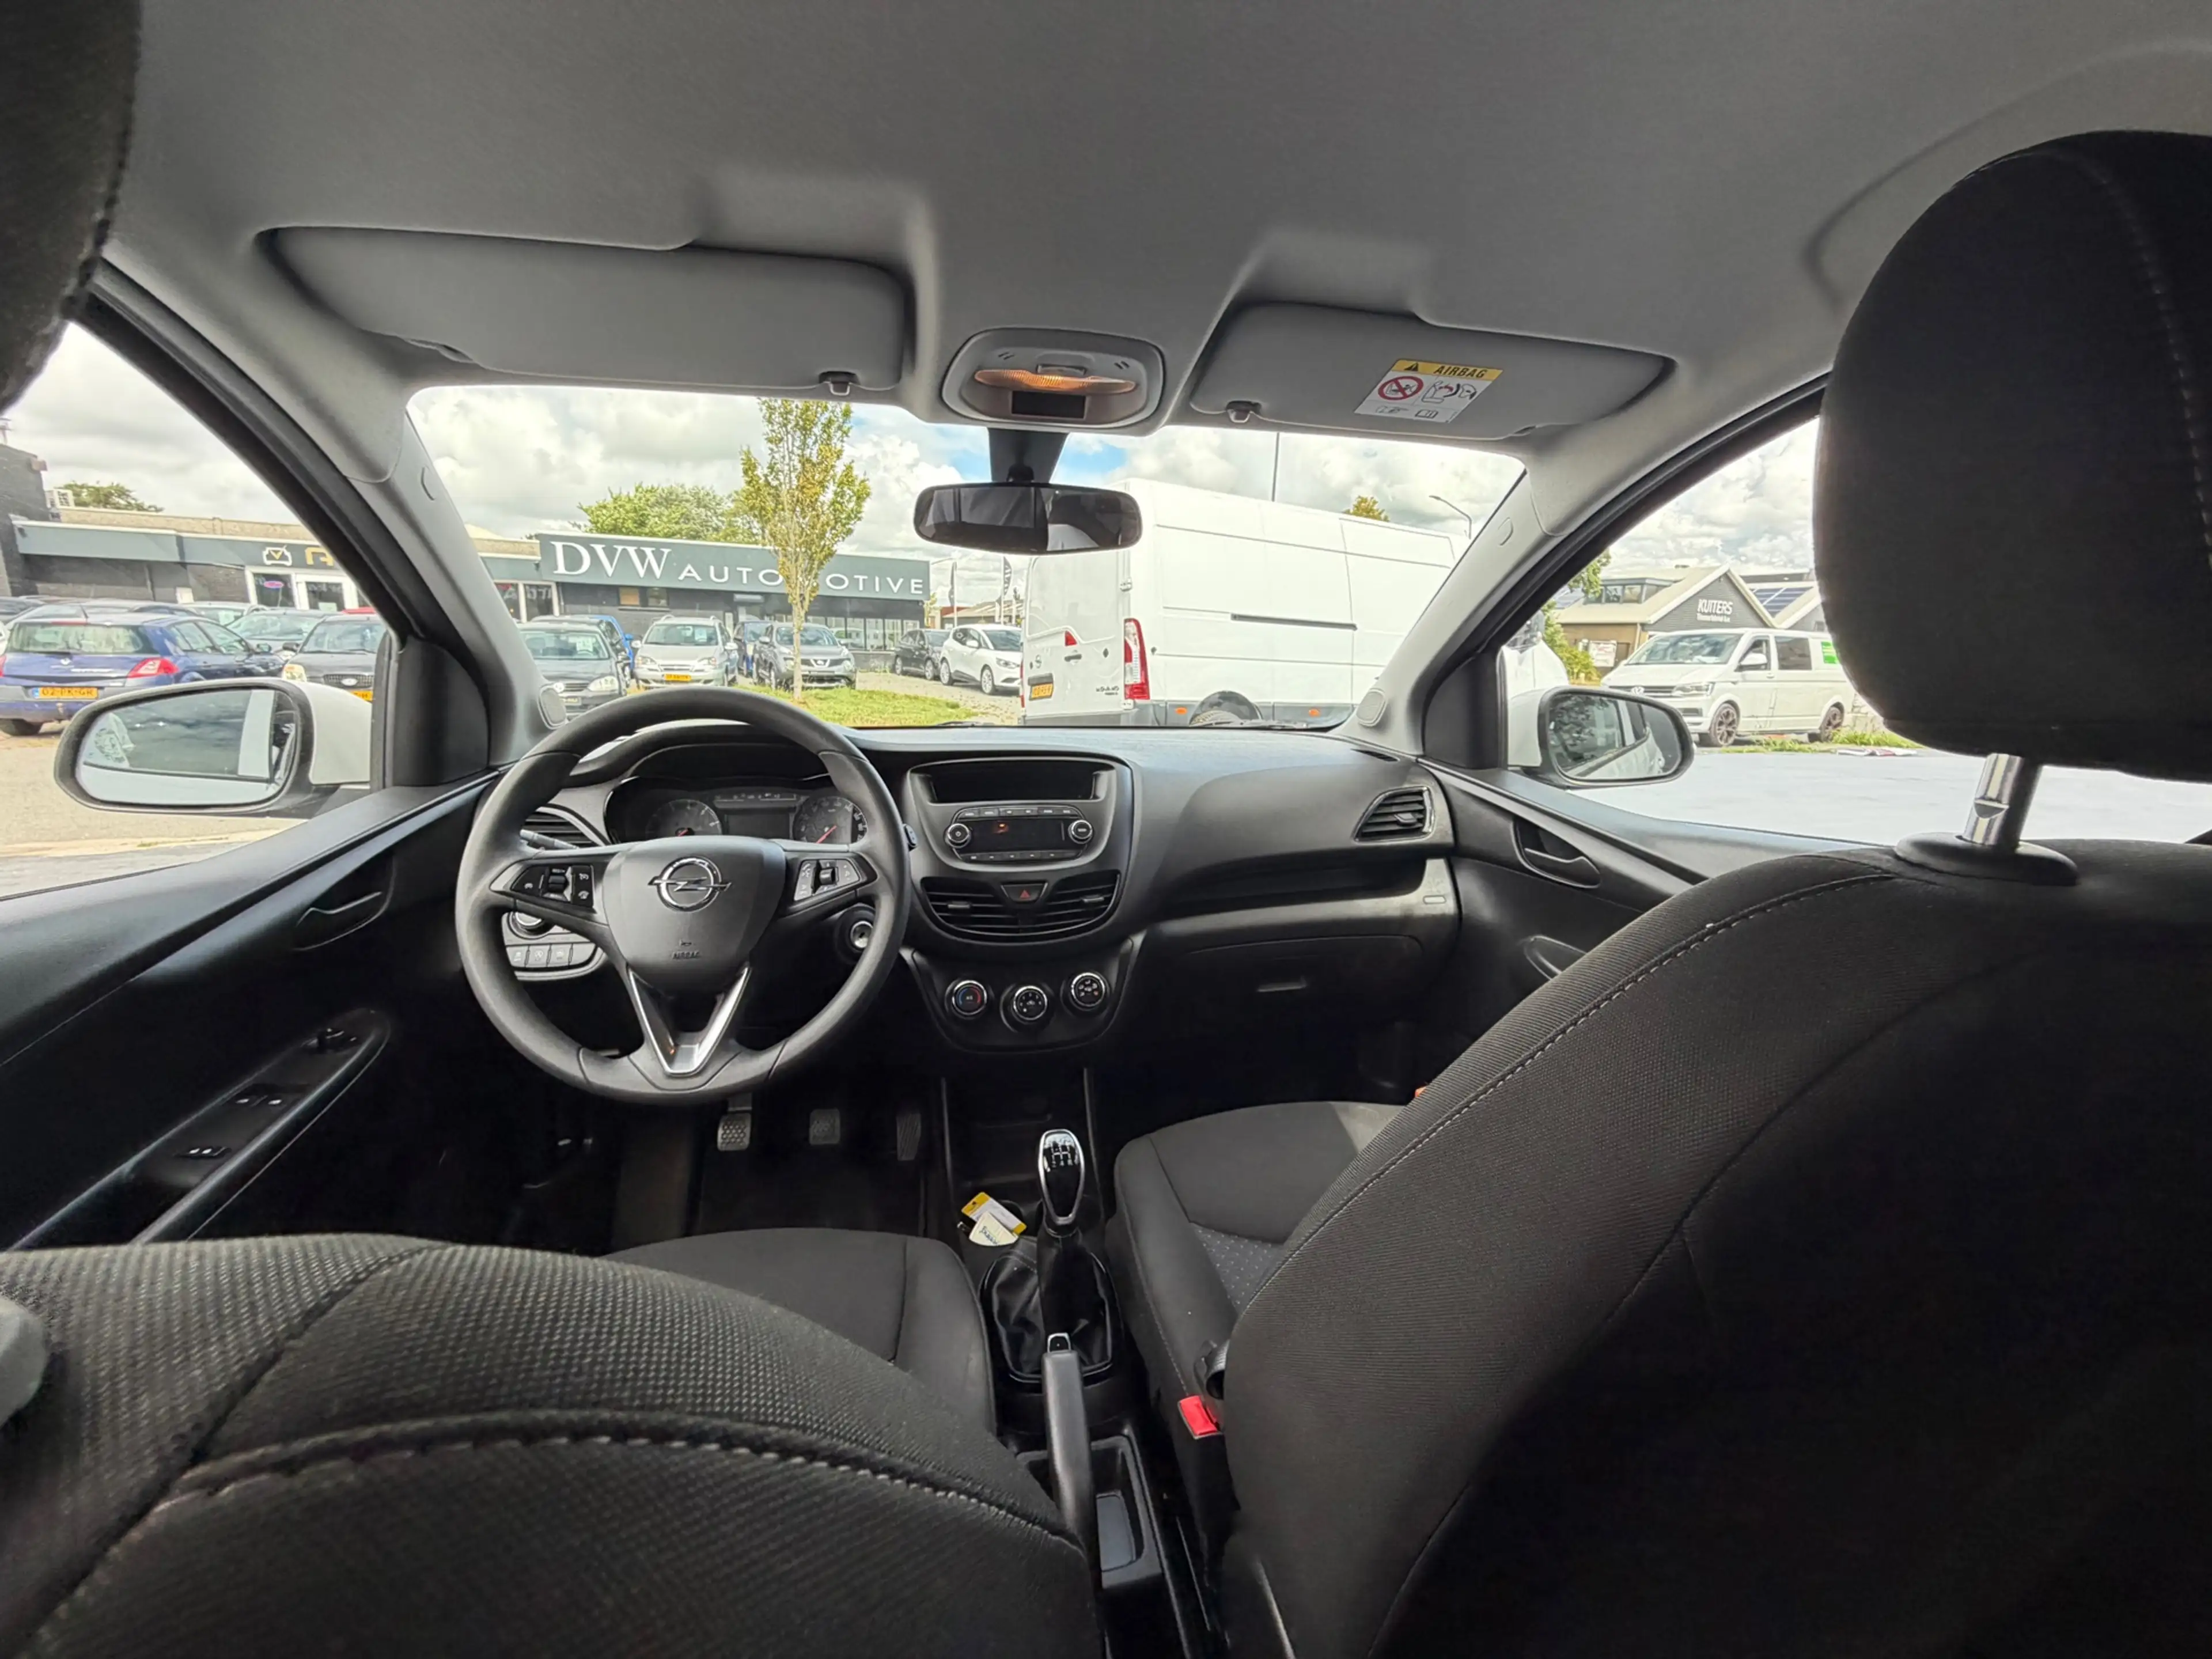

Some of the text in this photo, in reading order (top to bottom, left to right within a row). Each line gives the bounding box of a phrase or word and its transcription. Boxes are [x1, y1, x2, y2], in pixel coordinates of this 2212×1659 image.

[1433, 365, 1488, 378] AIRBAG
[550, 541, 923, 594] DVW AUTOOTIVE
[1696, 599, 1733, 615] KUITERS
